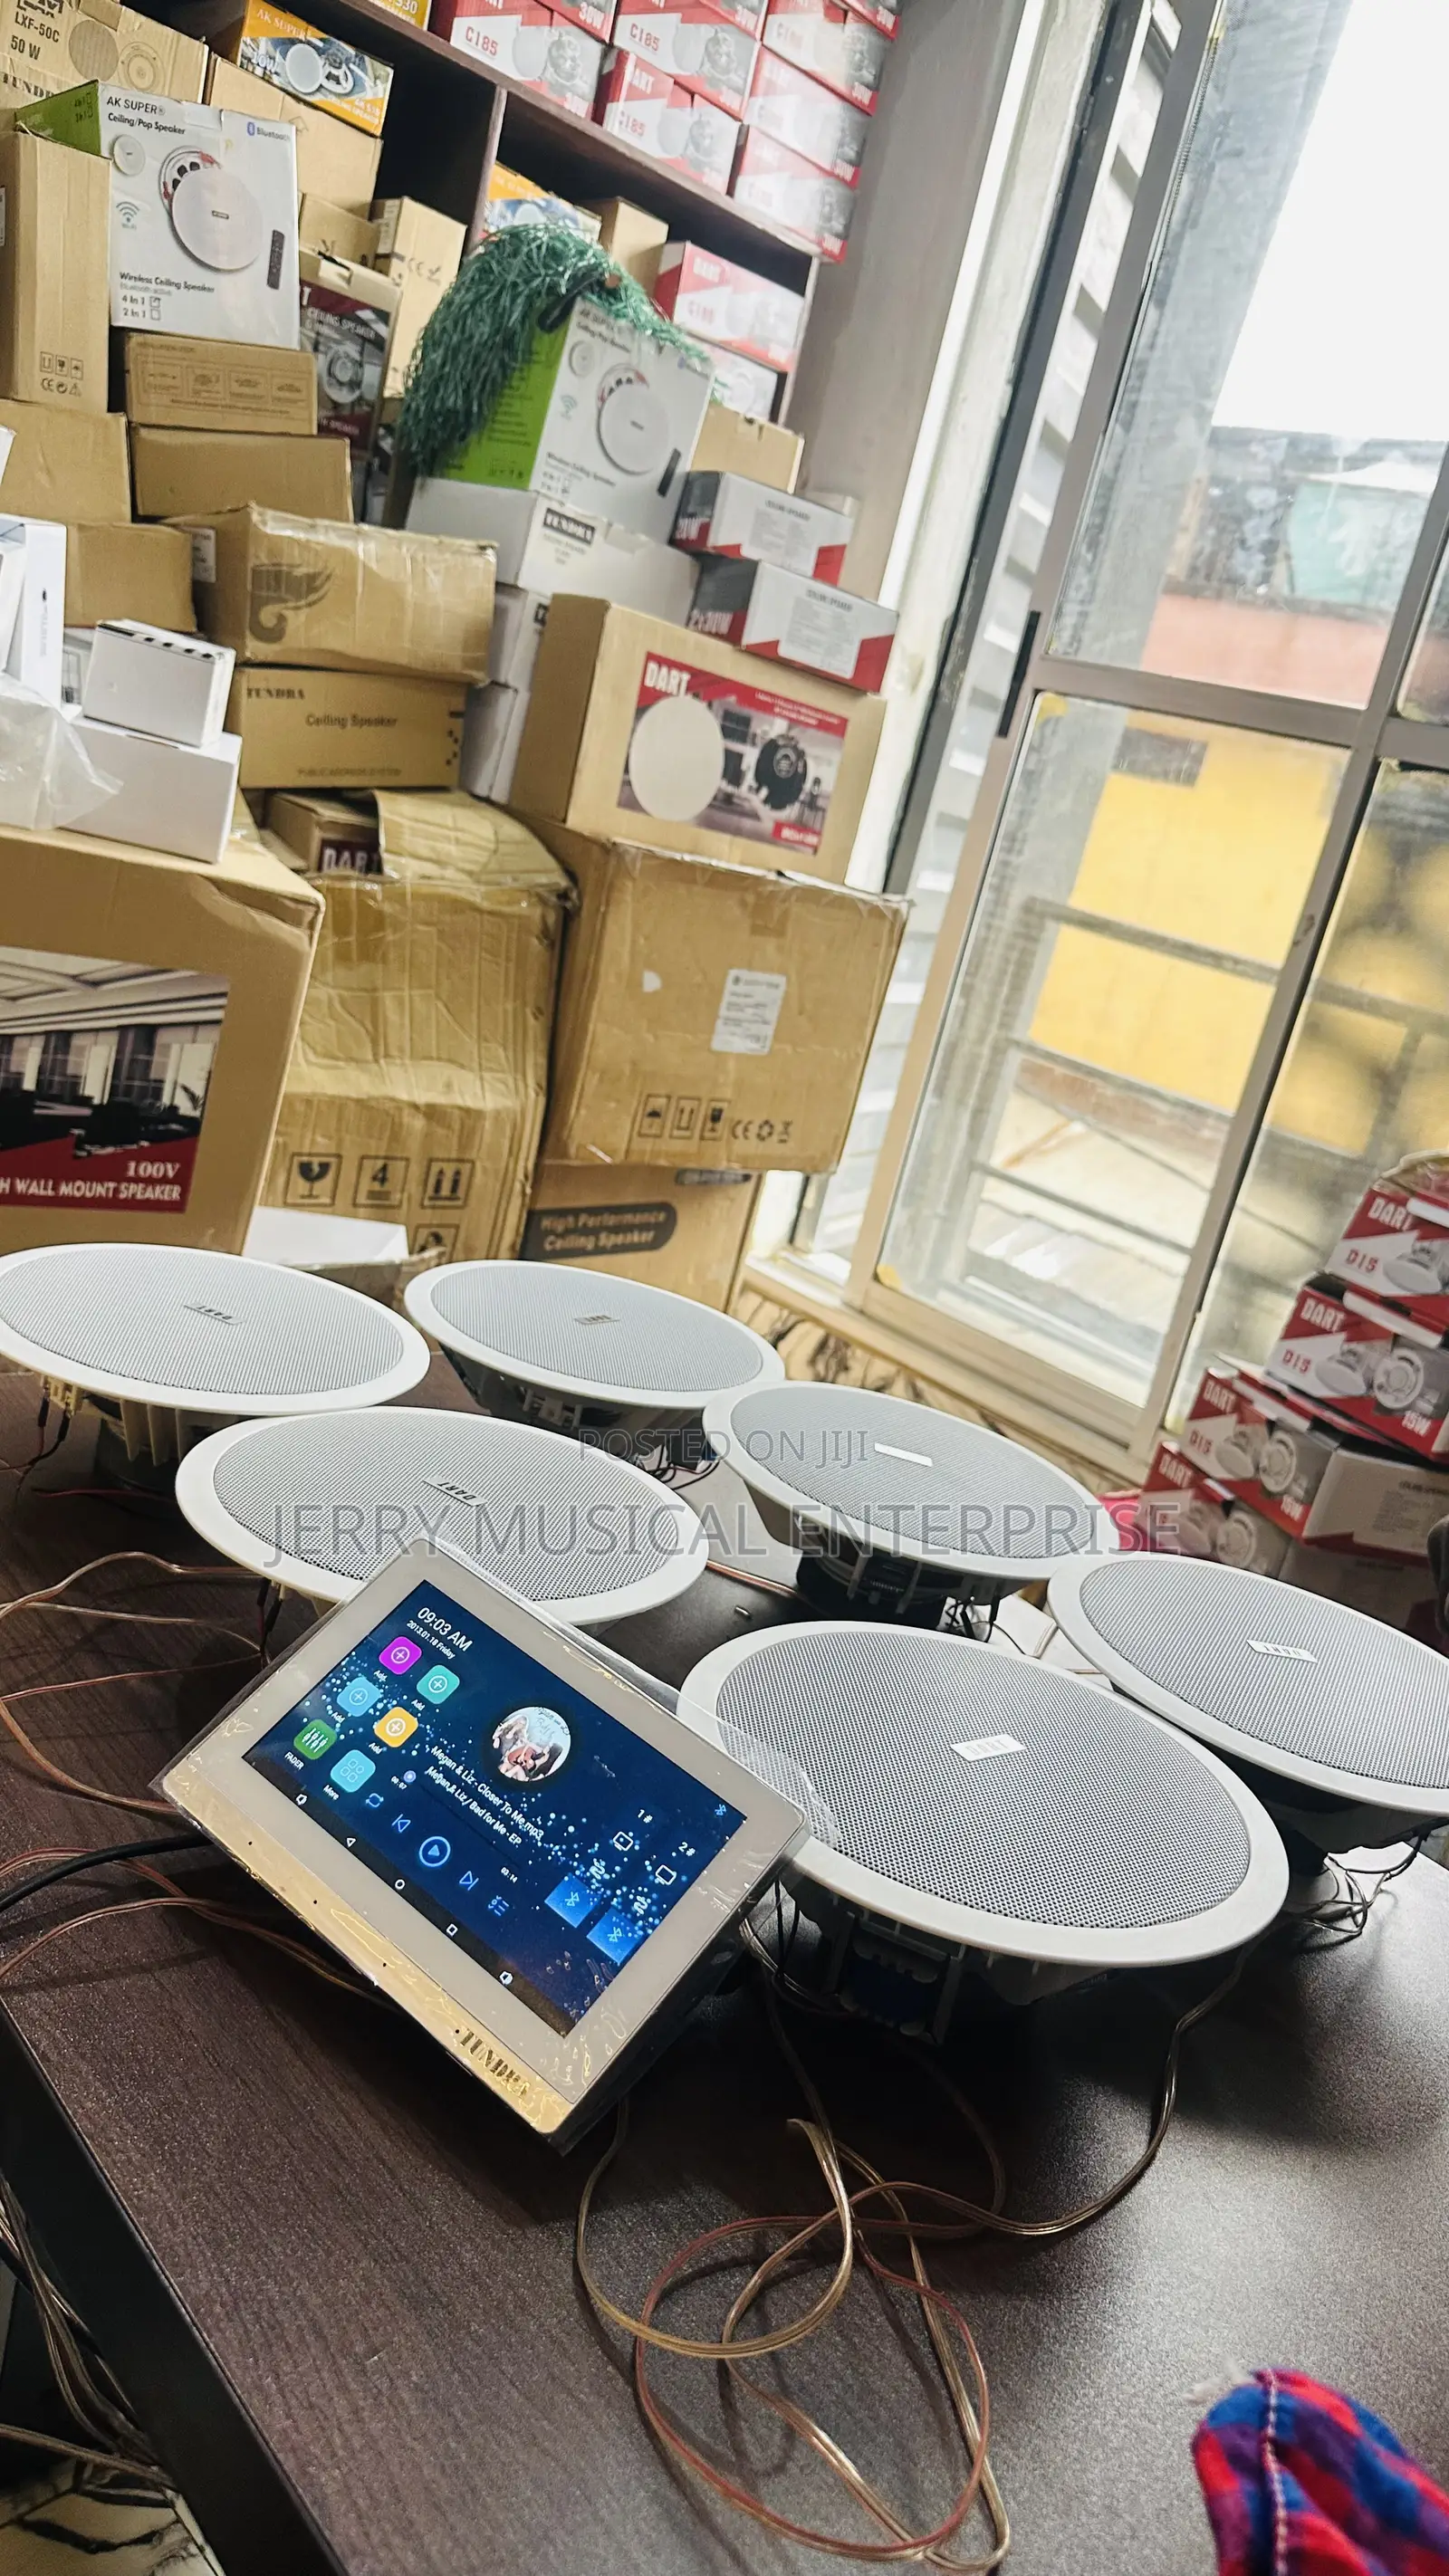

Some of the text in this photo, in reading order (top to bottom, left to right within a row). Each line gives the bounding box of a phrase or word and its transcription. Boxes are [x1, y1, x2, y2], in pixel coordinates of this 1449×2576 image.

[257, 8, 272, 24] AK
[14, 11, 60, 43] LXF-50C
[11, 34, 41, 60] 50 W
[106, 96, 121, 109] AK
[155, 121, 185, 135] Speaker
[120, 272, 152, 284] Wireless
[644, 661, 691, 697] DART
[246, 687, 305, 700] TUNDRA
[305, 713, 398, 729] Ceiling Speaker
[126, 1160, 180, 1179] 100V
[15, 1178, 55, 1196] WALL
[58, 1180, 118, 1198] MOUNT
[119, 1183, 181, 1201] SPEAKER
[541, 1210, 667, 1233] High Performance
[544, 1230, 655, 1251] Ceiling Speaker
[1300, 1298, 1346, 1333] DART
[1203, 1379, 1236, 1413] DART
[1401, 1410, 1432, 1437] 15W
[1158, 1452, 1194, 1489] DART
[437, 1481, 477, 1500] DART
[417, 1607, 474, 1652] 09:03 AM
[435, 1641, 456, 1660] Friday
[374, 1670, 388, 1681] Add
[411, 1699, 426, 1711] Add
[331, 1711, 346, 1724] Add
[368, 1742, 383, 1755] Add
[284, 1751, 304, 1770] FADER
[430, 1745, 457, 1771] Megan
[455, 1765, 464, 1776] &
[461, 1771, 476, 1786] Liz
[477, 1783, 504, 1807] Closer
[501, 1801, 513, 1815] To
[323, 1785, 340, 1801] More
[469, 1800, 487, 1817] Bad
[482, 1812, 496, 1825] for
[492, 1820, 507, 1835] Me
[508, 1833, 523, 1844] EP
